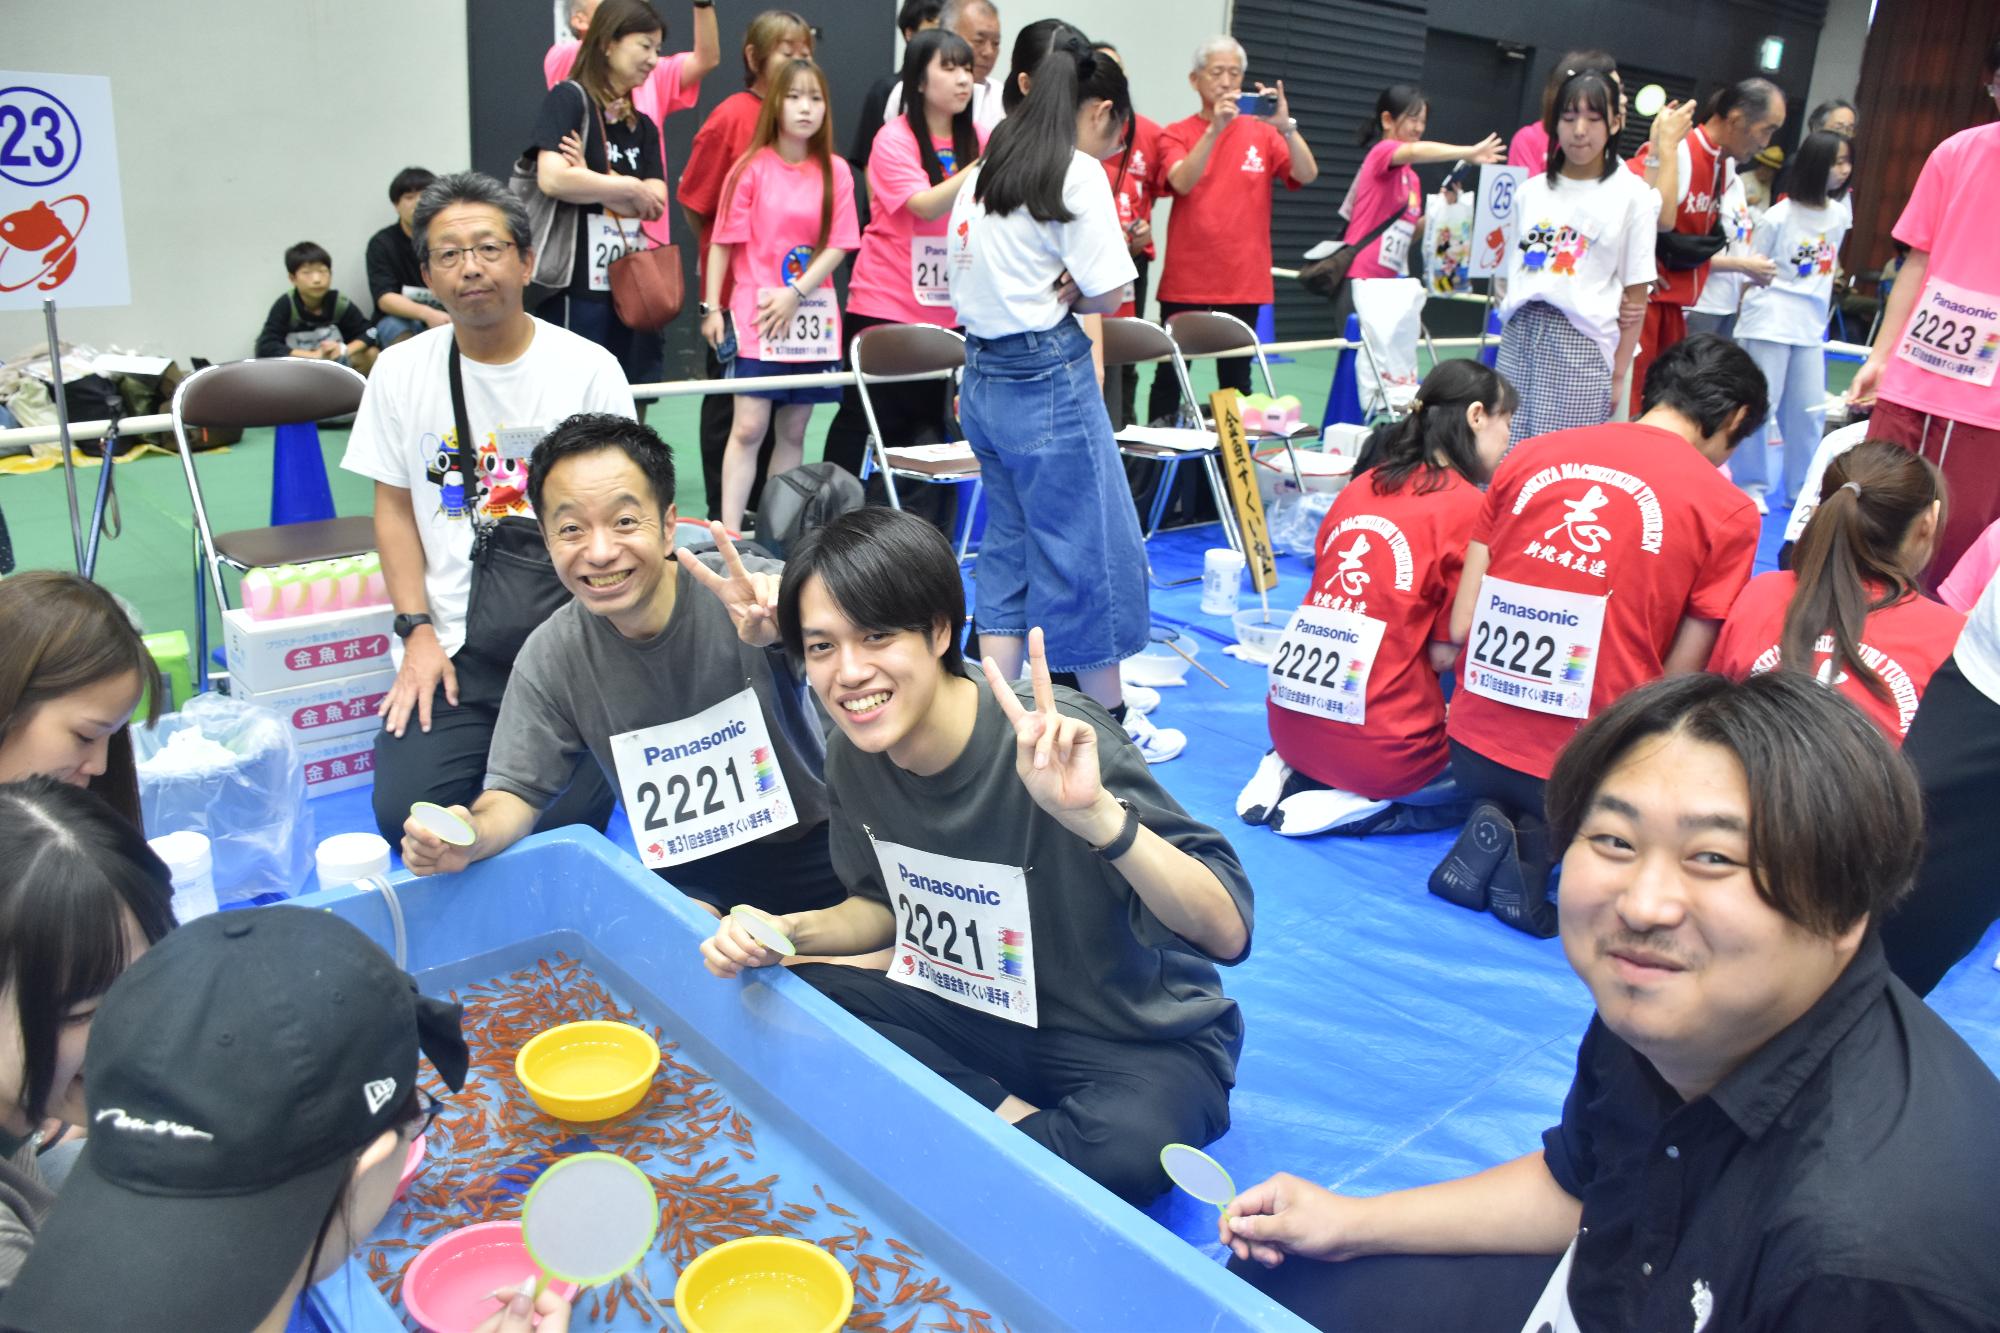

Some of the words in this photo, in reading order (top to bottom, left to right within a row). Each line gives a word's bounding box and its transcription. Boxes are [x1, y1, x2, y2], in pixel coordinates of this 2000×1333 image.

[0, 104, 65, 168] 23
[1493, 181, 1513, 210] 25
[1932, 291, 1998, 320] Panasonic
[1911, 309, 1976, 355] 2223
[1544, 485, 1611, 553] 志
[1325, 533, 1371, 596] 志
[1296, 618, 1359, 644] Panasonic
[1490, 595, 1579, 627] Panasonic
[294, 638, 382, 669] 金魚ポイ
[1273, 641, 1340, 689] 2222
[1473, 621, 1555, 678] 2222
[1480, 672, 1564, 708] 第31回全国金魚すくい選手権
[644, 720, 746, 766] Panasonic
[637, 757, 745, 832] 2221
[667, 808, 773, 856] 第31回全国金魚すくい選手権
[898, 862, 1001, 906] Panasonic
[900, 893, 984, 971] 2221
[918, 960, 1010, 1009] 第31回全国金魚すくい選手権
